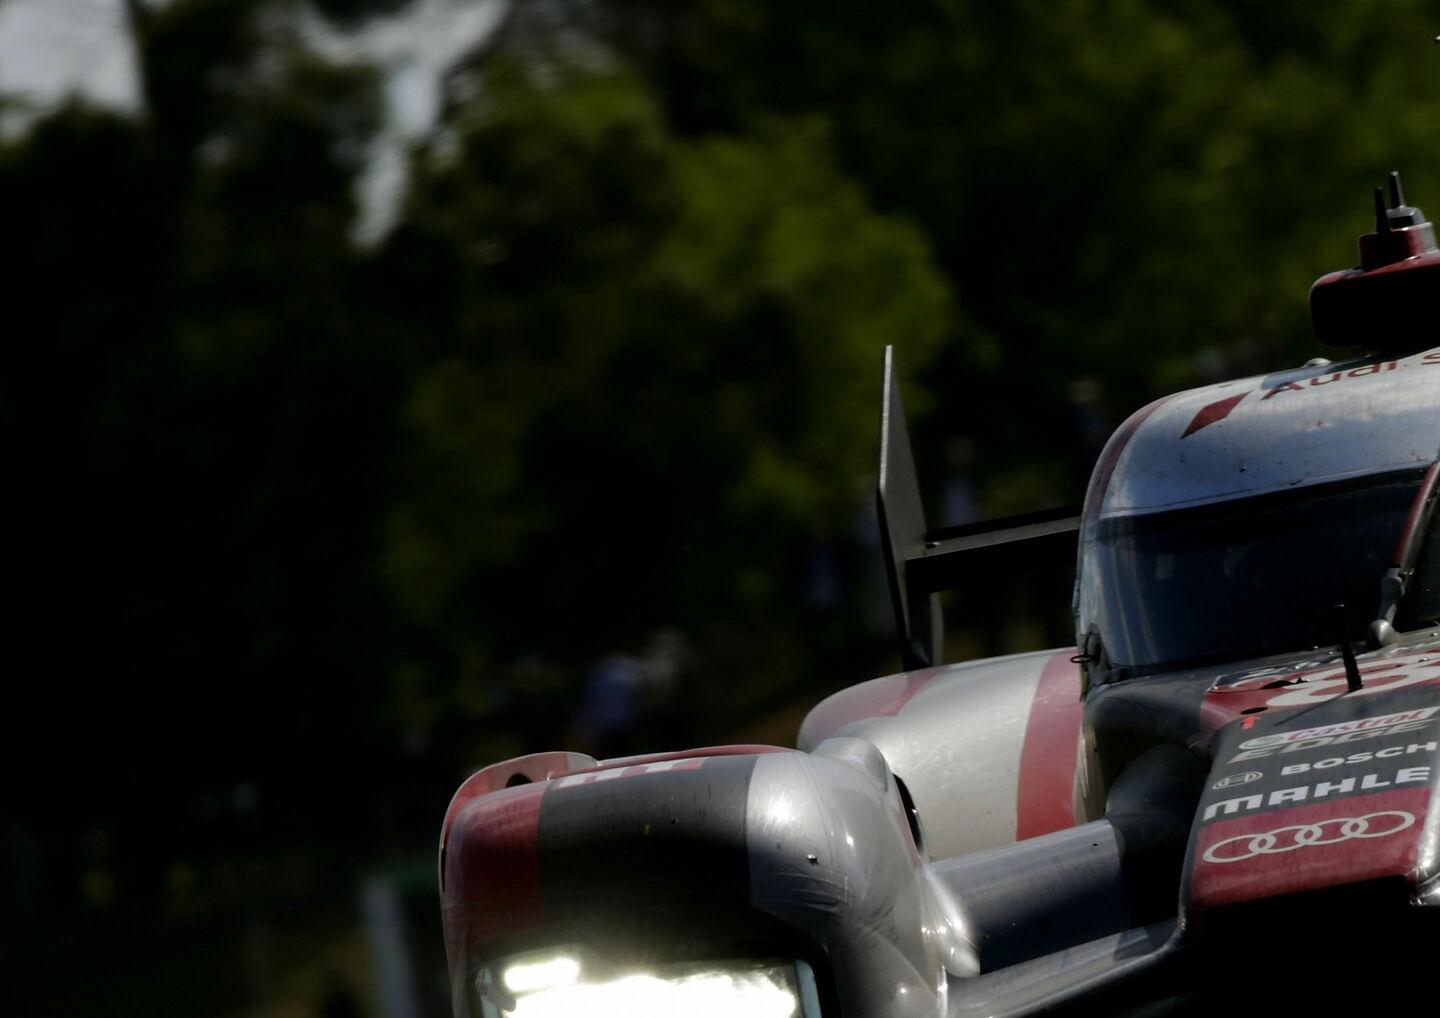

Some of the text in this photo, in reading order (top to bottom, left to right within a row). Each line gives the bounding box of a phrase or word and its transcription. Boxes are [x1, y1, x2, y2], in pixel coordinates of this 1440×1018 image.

[1261, 359, 1397, 401] Audi
[1227, 719, 1437, 765] EDGE
[1286, 709, 1421, 742] Castrol
[1281, 741, 1438, 776] BOSCH
[1202, 766, 1432, 821] MAHLE
